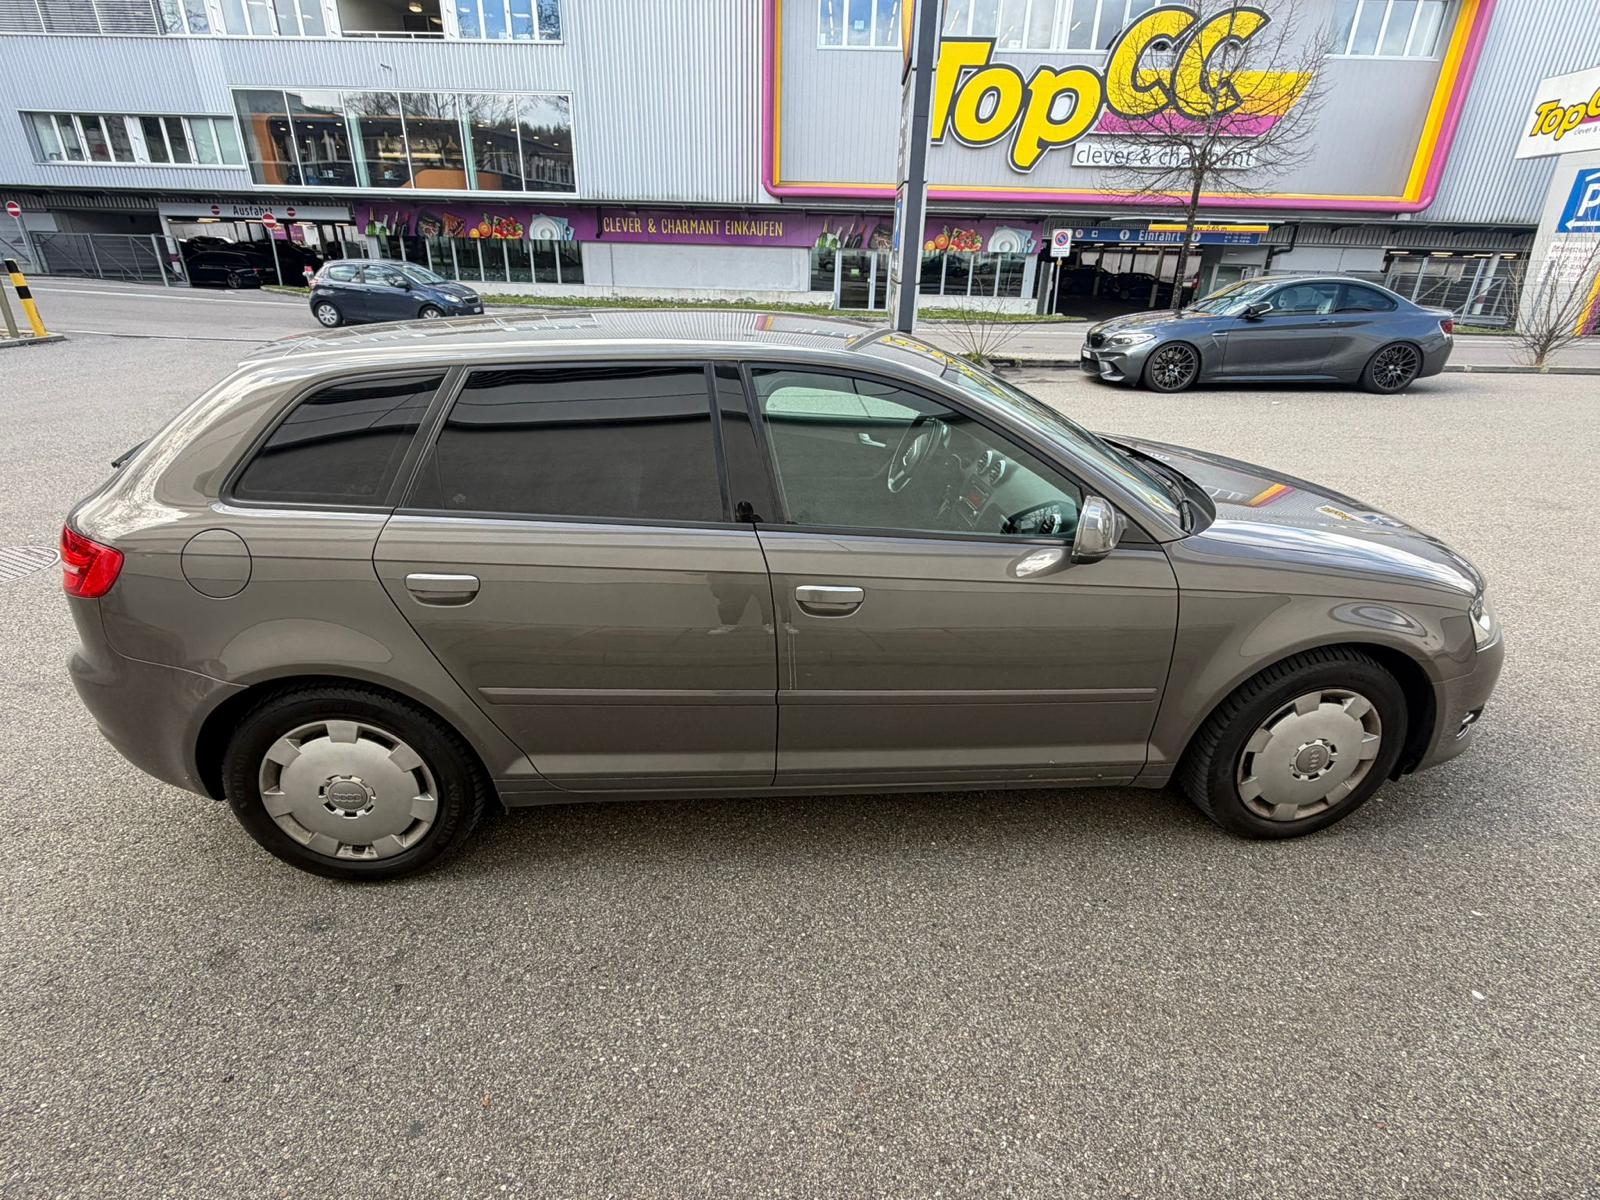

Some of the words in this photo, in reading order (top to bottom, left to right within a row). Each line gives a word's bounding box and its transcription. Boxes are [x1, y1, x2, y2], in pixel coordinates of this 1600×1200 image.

[931, 5, 1272, 173] TopCC
[1076, 144, 1131, 164] clever
[1140, 148, 1151, 165] &
[1159, 145, 1252, 167] chaant
[603, 217, 642, 233] CLEVER
[648, 218, 657, 233] &
[661, 218, 721, 235] CHARMANT
[725, 220, 783, 237] EINKAUFEN
